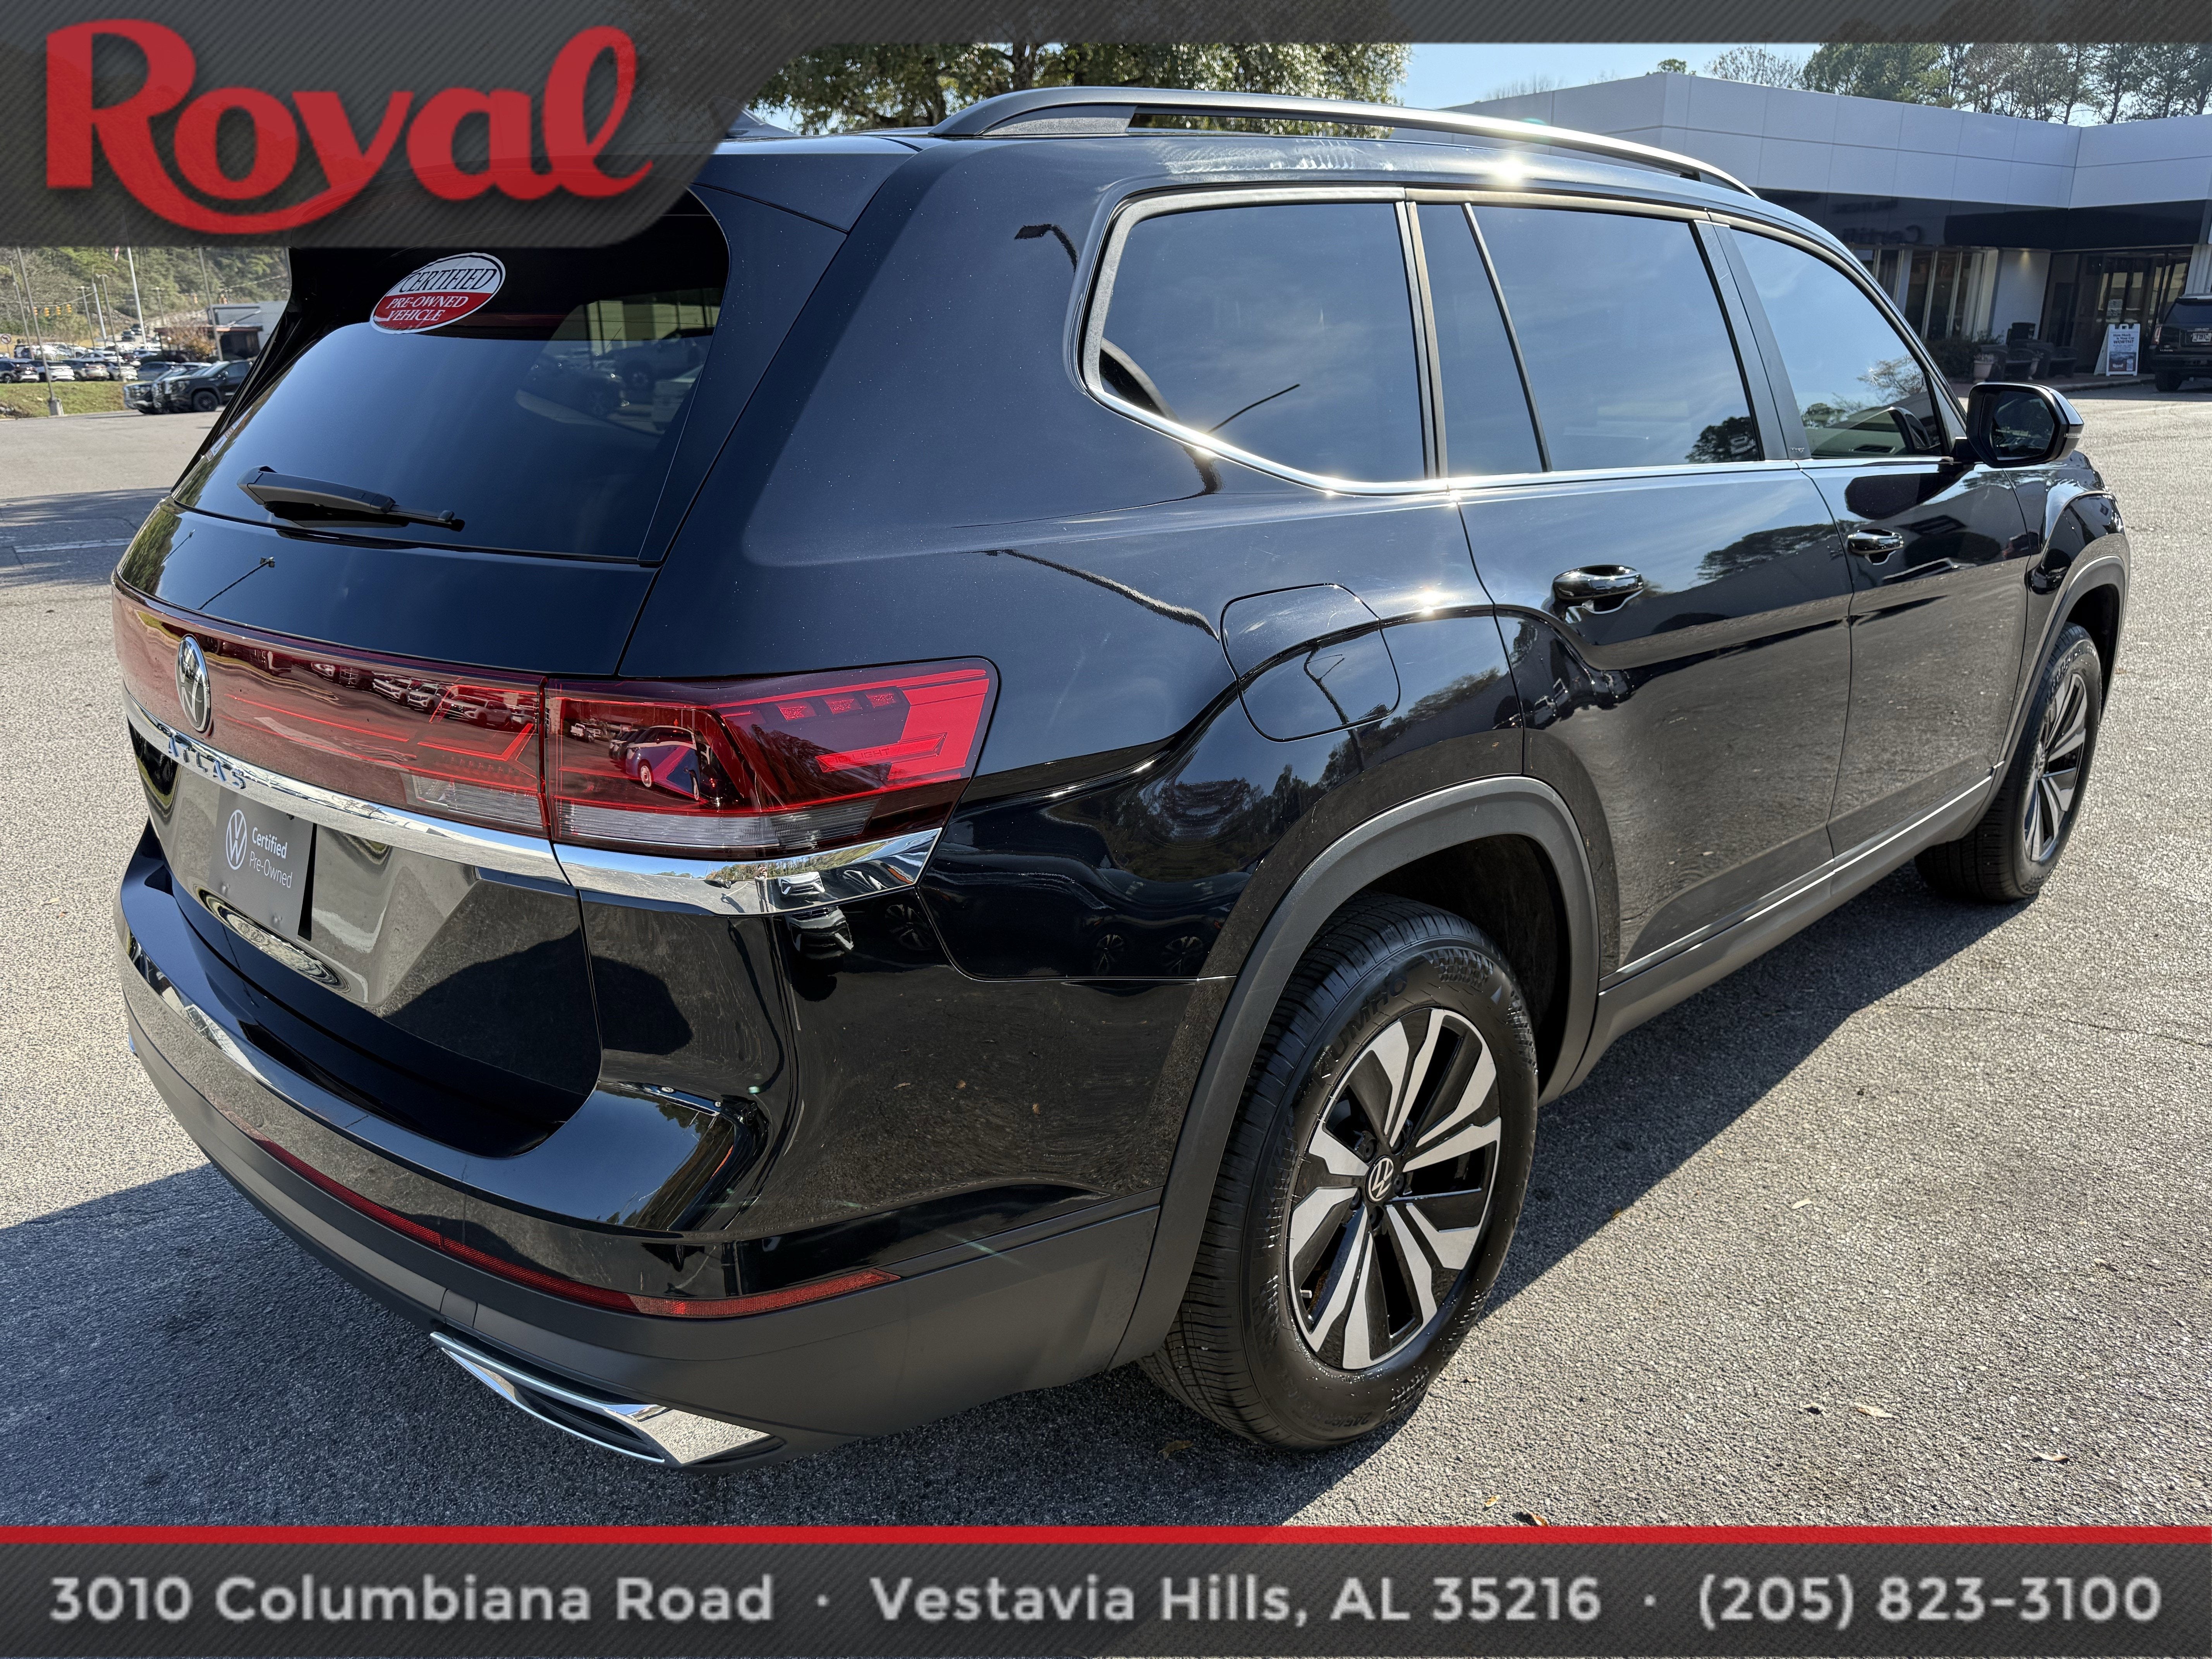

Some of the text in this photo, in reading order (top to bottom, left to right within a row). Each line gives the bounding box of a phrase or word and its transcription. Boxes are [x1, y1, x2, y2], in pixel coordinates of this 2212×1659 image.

[399, 268, 497, 293] CERTIFIED
[386, 296, 469, 309] PRE-OWNED
[387, 309, 445, 321] VEHICLE
[168, 736, 247, 790] ATLAS
[252, 827, 288, 859] Certified
[249, 851, 293, 889] Pre-Owned
